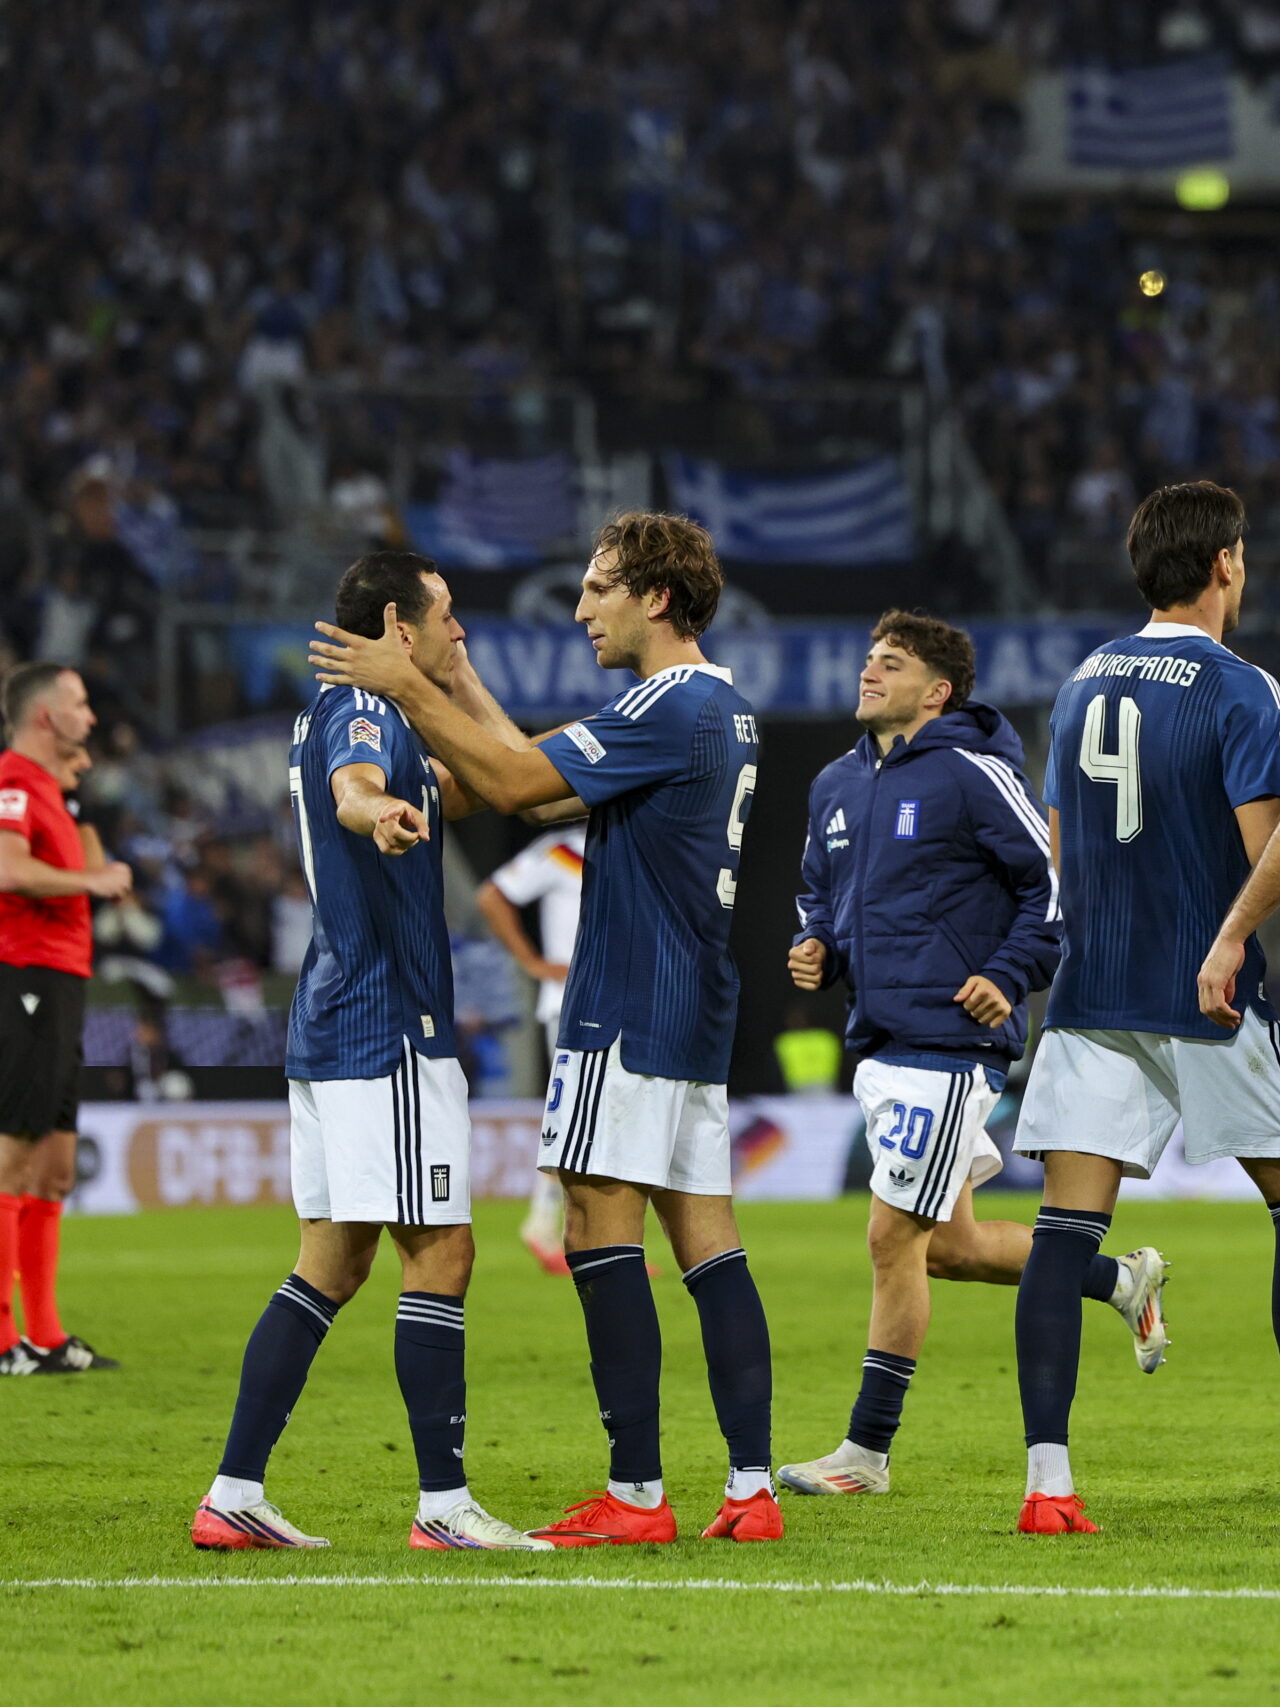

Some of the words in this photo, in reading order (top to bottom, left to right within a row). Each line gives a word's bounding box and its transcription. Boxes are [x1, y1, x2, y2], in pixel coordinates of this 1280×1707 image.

[1073, 653, 1201, 687] MAVROPANOS
[1079, 694, 1143, 843] 4
[879, 1103, 934, 1160] 20
